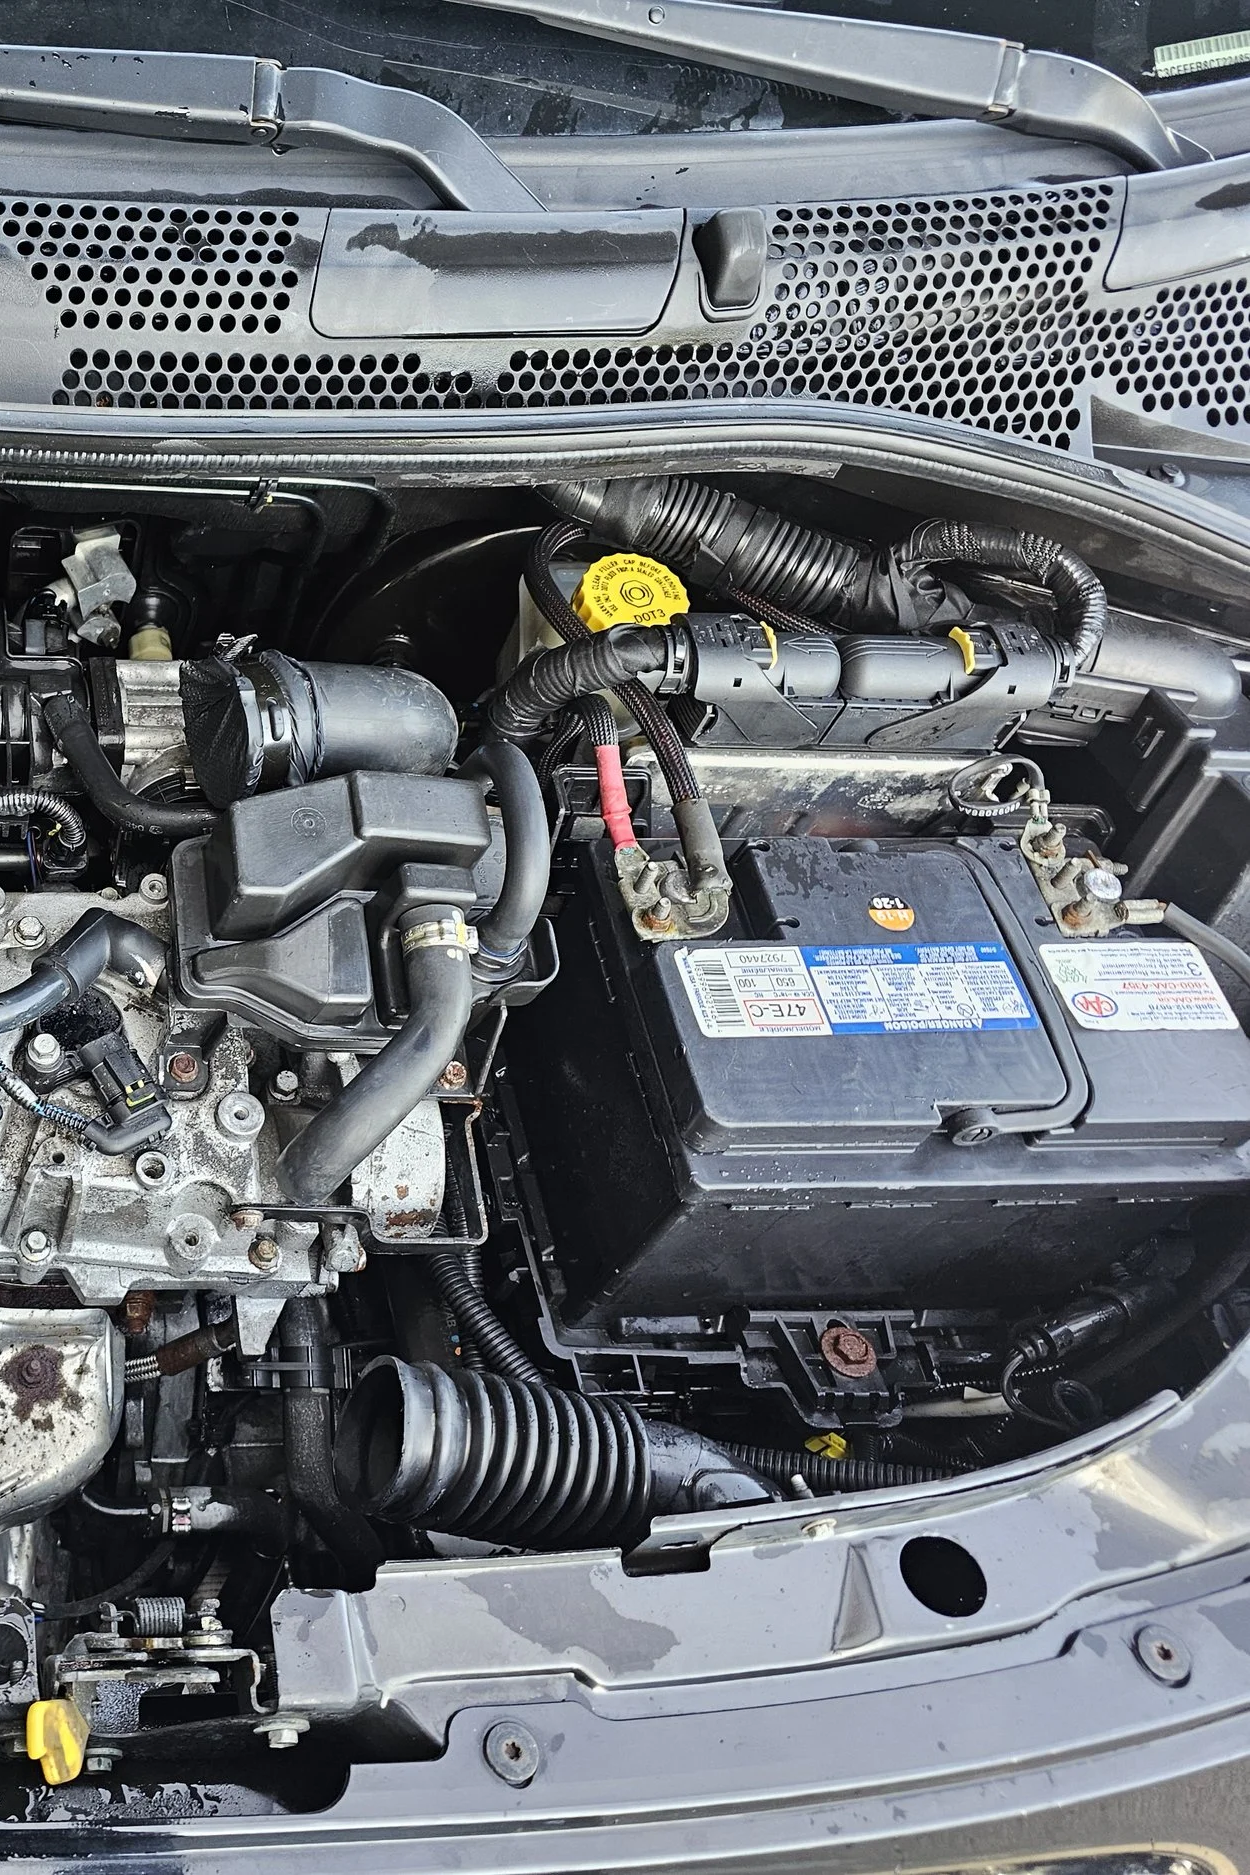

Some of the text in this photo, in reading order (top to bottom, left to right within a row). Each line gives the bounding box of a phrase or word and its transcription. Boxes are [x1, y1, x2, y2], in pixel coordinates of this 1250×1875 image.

[600, 561, 618, 573] FILLER
[640, 562, 661, 574] BEFORE
[634, 608, 666, 624] DOT3
[873, 898, 904, 909] 1-20
[1186, 962, 1202, 976] 3
[738, 977, 795, 988] 650 100
[749, 1003, 806, 1017] 47E-C
[1077, 995, 1114, 1017] CAA
